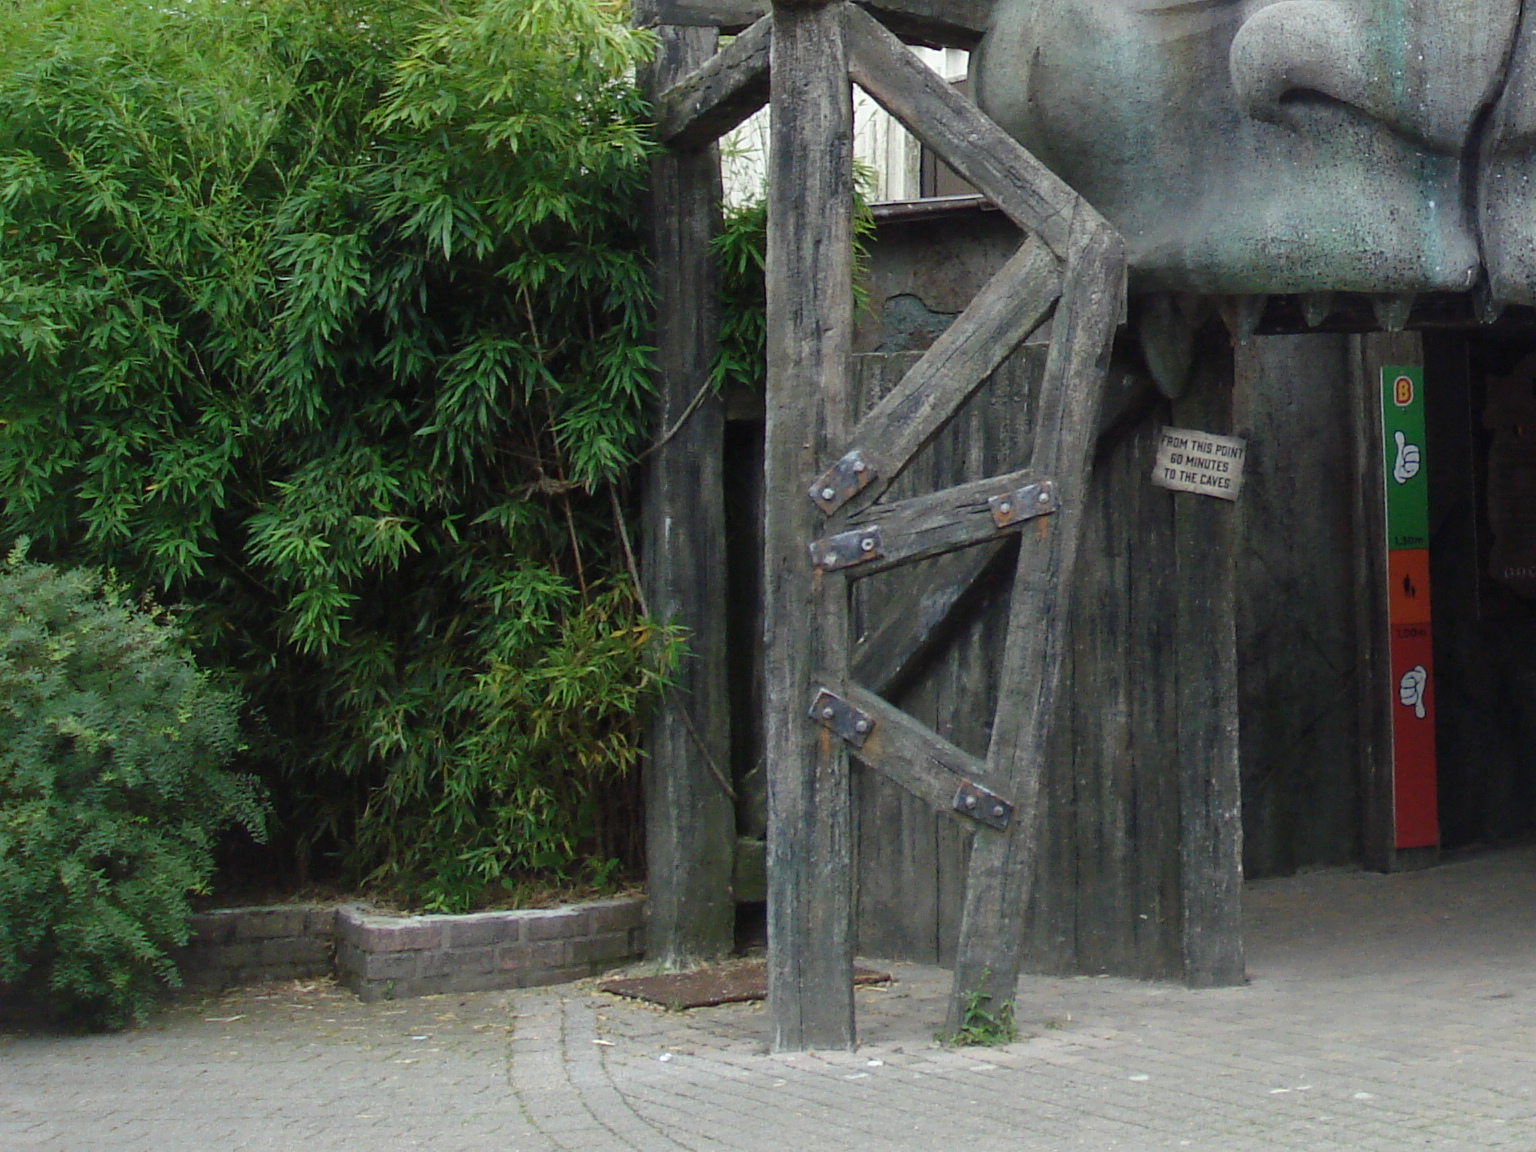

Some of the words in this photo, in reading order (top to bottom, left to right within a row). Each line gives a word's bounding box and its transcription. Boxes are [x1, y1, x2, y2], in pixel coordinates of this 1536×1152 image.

[1161, 434, 1189, 449] FROM
[1191, 440, 1213, 454] THIS
[1214, 444, 1243, 460] POINT
[1170, 453, 1183, 465] 60
[1185, 456, 1229, 473] MINUTES
[1164, 468, 1176, 480] TO
[1179, 470, 1197, 484] THE
[1199, 474, 1231, 489] CAVES
